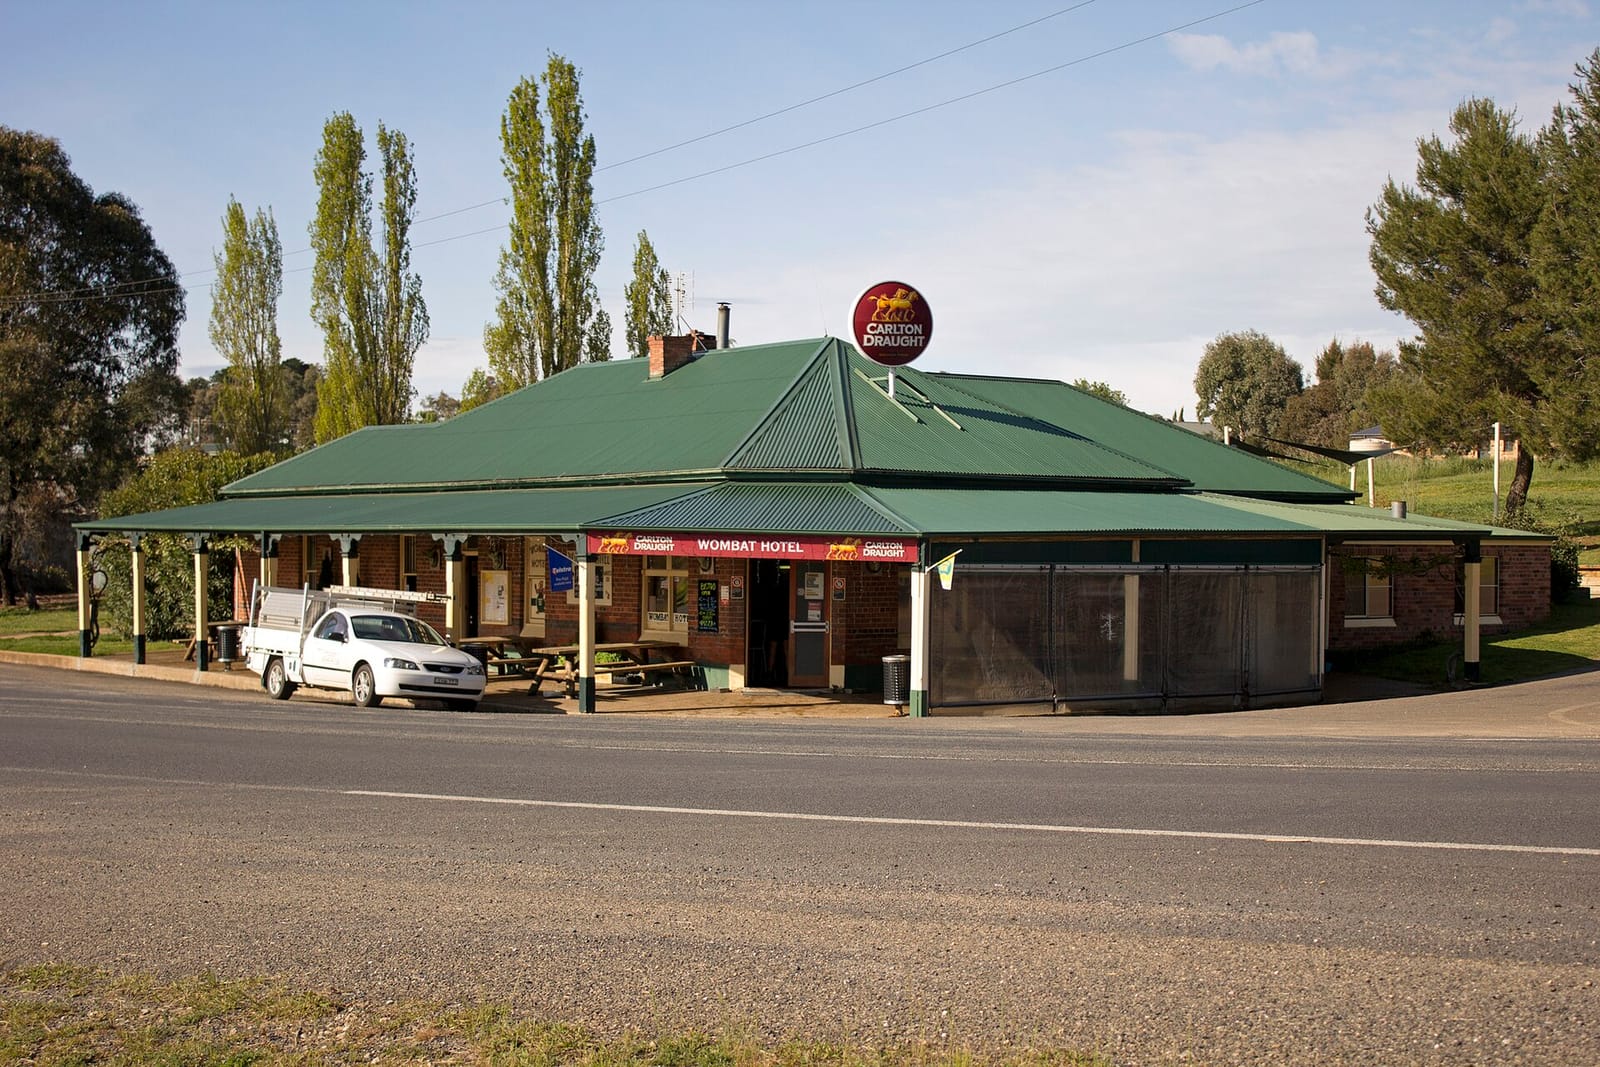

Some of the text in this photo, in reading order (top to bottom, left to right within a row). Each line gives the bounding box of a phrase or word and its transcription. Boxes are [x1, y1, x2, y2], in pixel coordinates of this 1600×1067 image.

[866, 322, 923, 335] CARLTON
[863, 334, 926, 347] DRAUGHT
[635, 535, 673, 544] CARLTON
[634, 542, 675, 552] DRAUGHT
[697, 539, 804, 553] WOMBAT HOTEL
[865, 541, 903, 550] CARLTON
[863, 549, 905, 558] DRAUGHT
